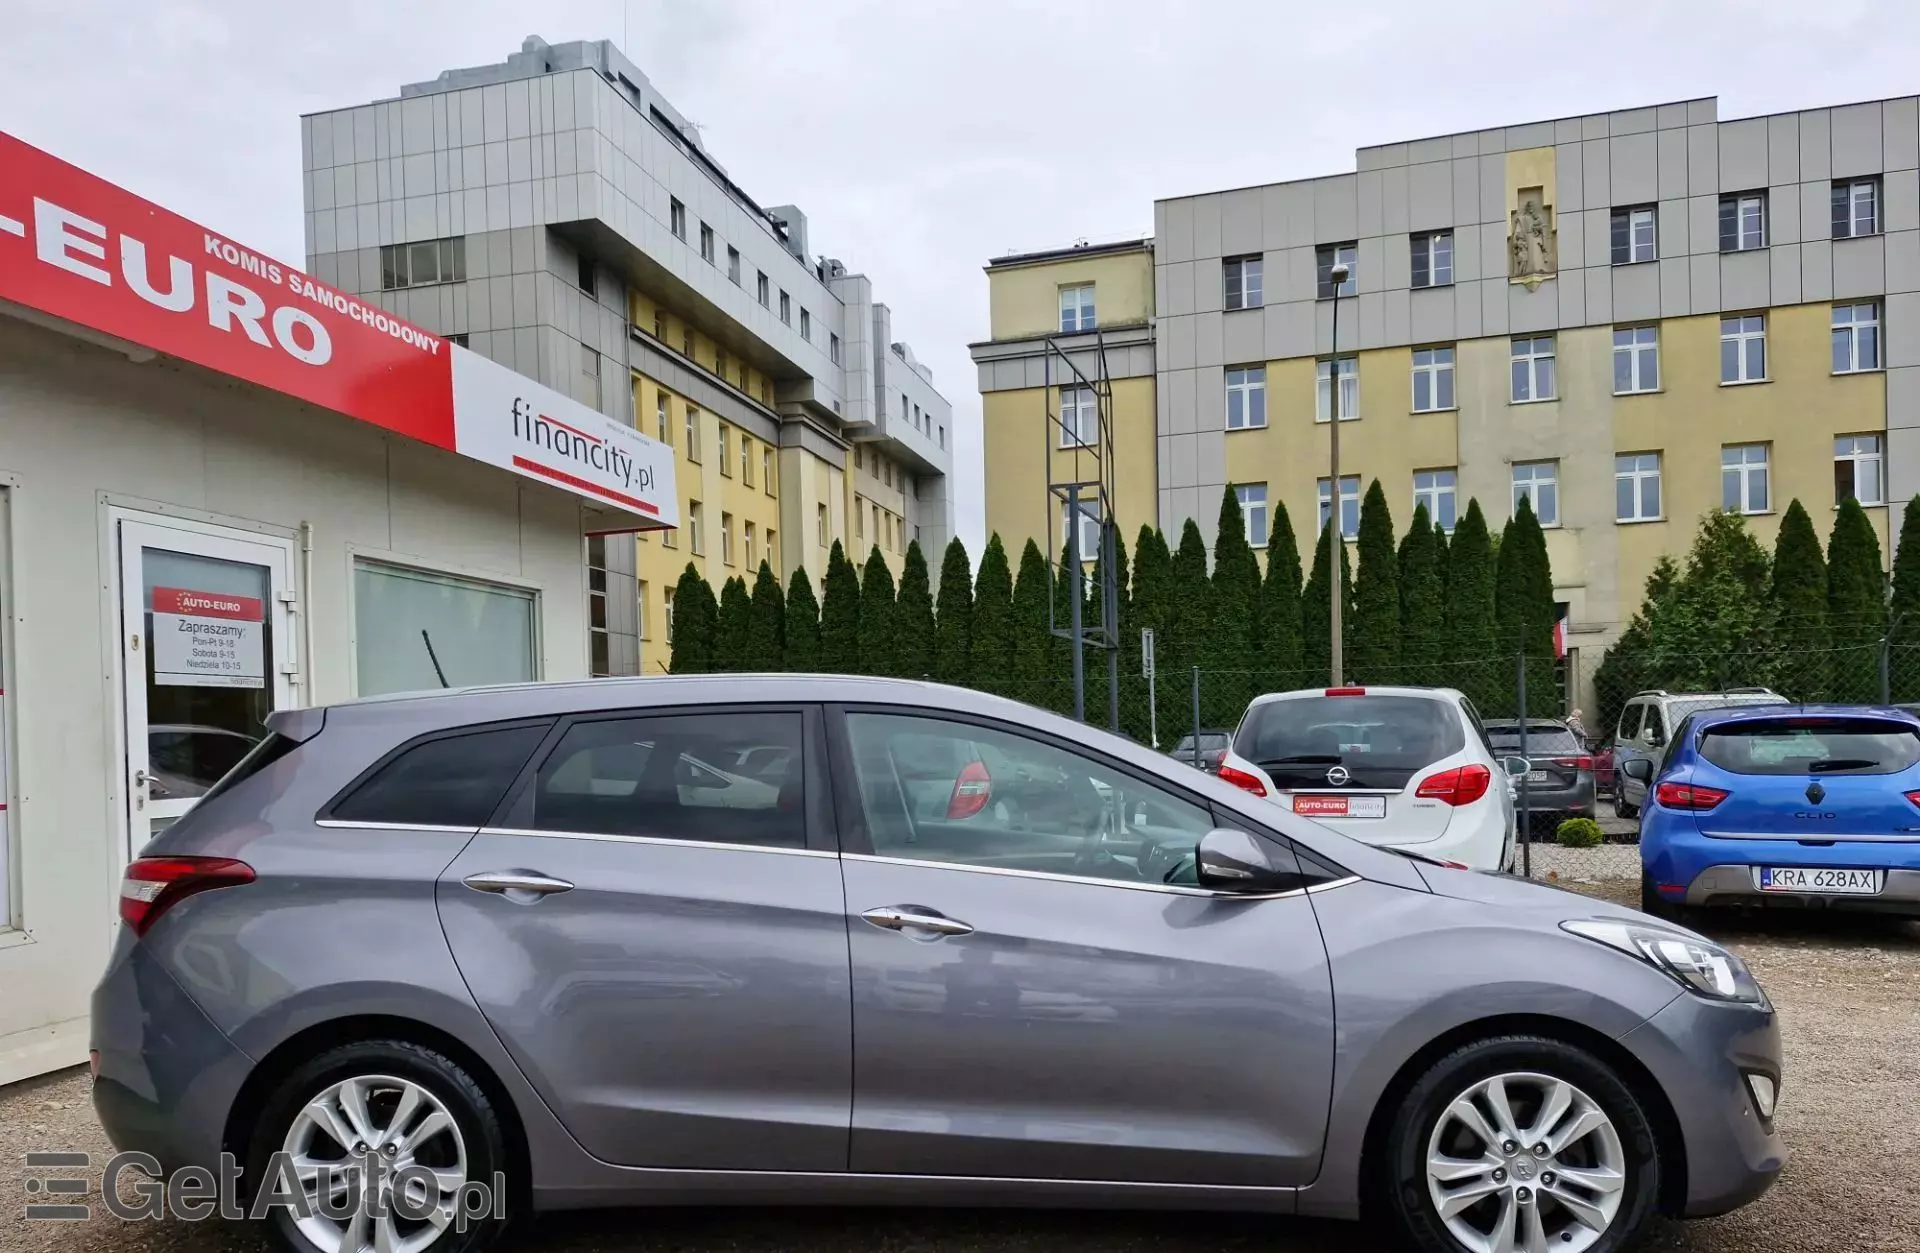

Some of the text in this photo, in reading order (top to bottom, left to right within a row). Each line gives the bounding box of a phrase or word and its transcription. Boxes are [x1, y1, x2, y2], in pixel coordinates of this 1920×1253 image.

[204, 234, 440, 356] KOMIS SAMOCHODOWY
[512, 397, 654, 492] financity.pl
[183, 597, 240, 612] AUTO-EURO
[186, 659, 219, 669] Niedziela
[1299, 802, 1346, 810] AUTO-EURO
[1772, 870, 1807, 886] KRA
[1814, 871, 1871, 888] 628AX
